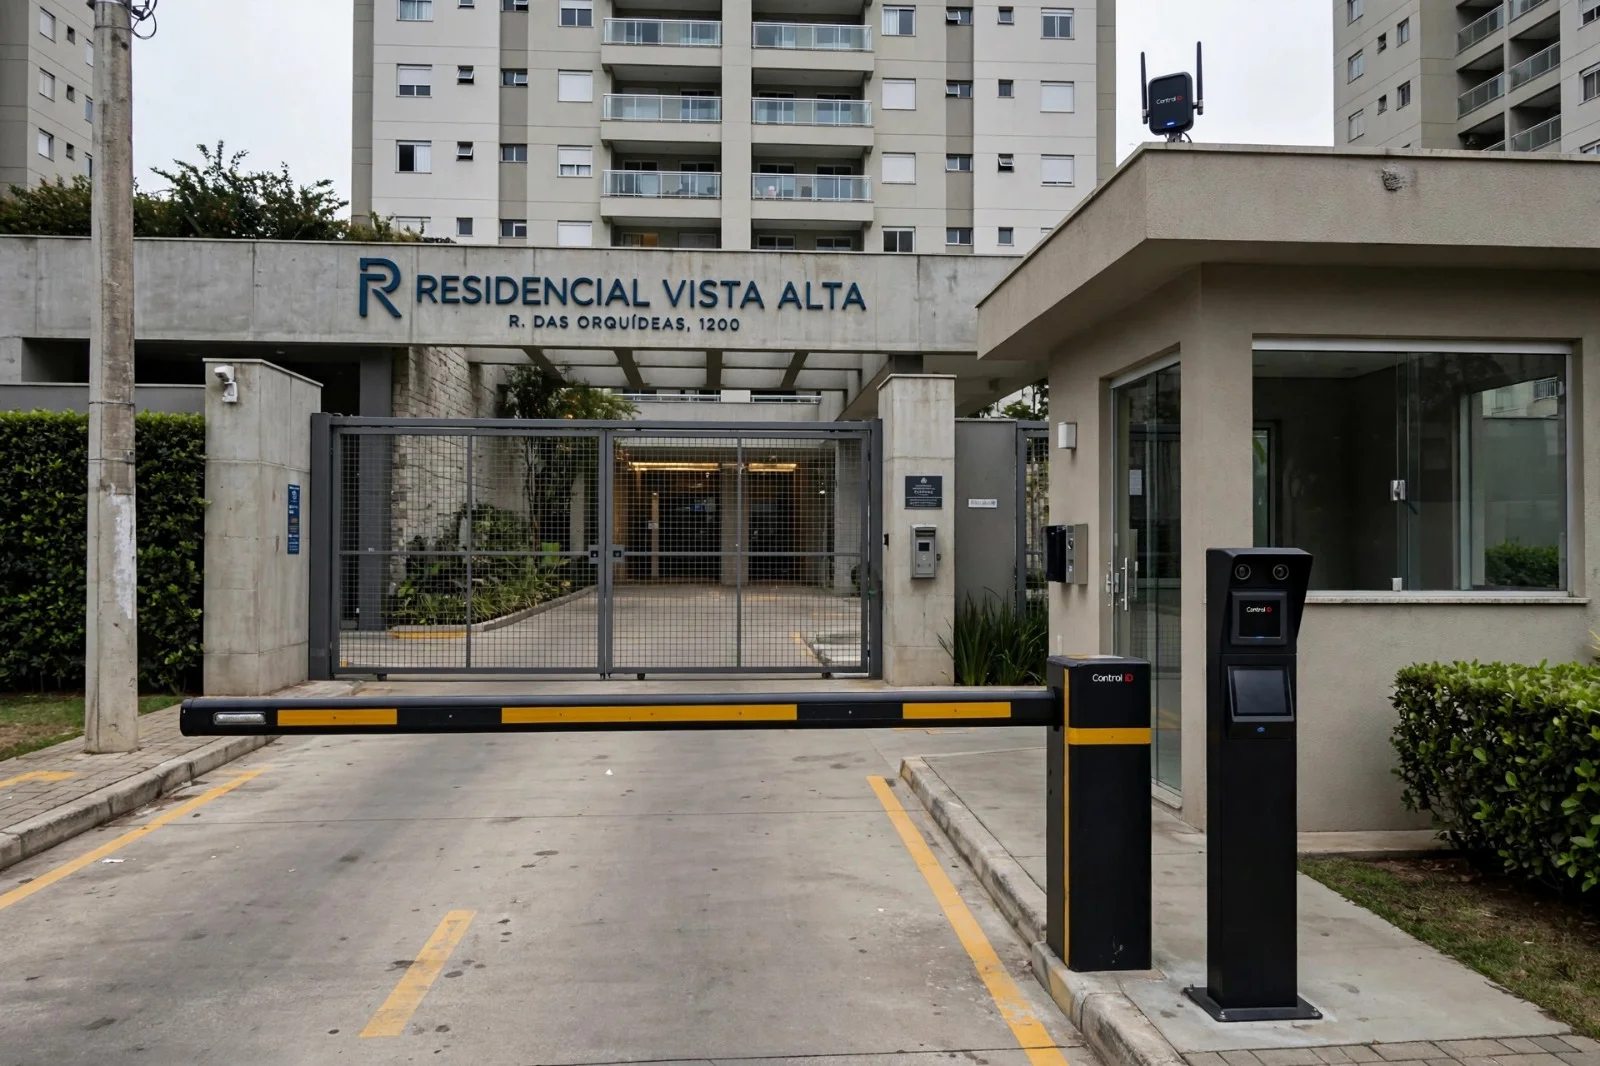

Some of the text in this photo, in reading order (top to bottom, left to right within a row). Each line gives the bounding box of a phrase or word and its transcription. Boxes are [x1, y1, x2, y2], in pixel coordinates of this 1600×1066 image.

[416, 274, 867, 312] RESIDENCIAL VISTA ALTA
[509, 313, 740, 332] R. DAS ORQUÍDEAS, 1200
[1092, 673, 1123, 682] Control
